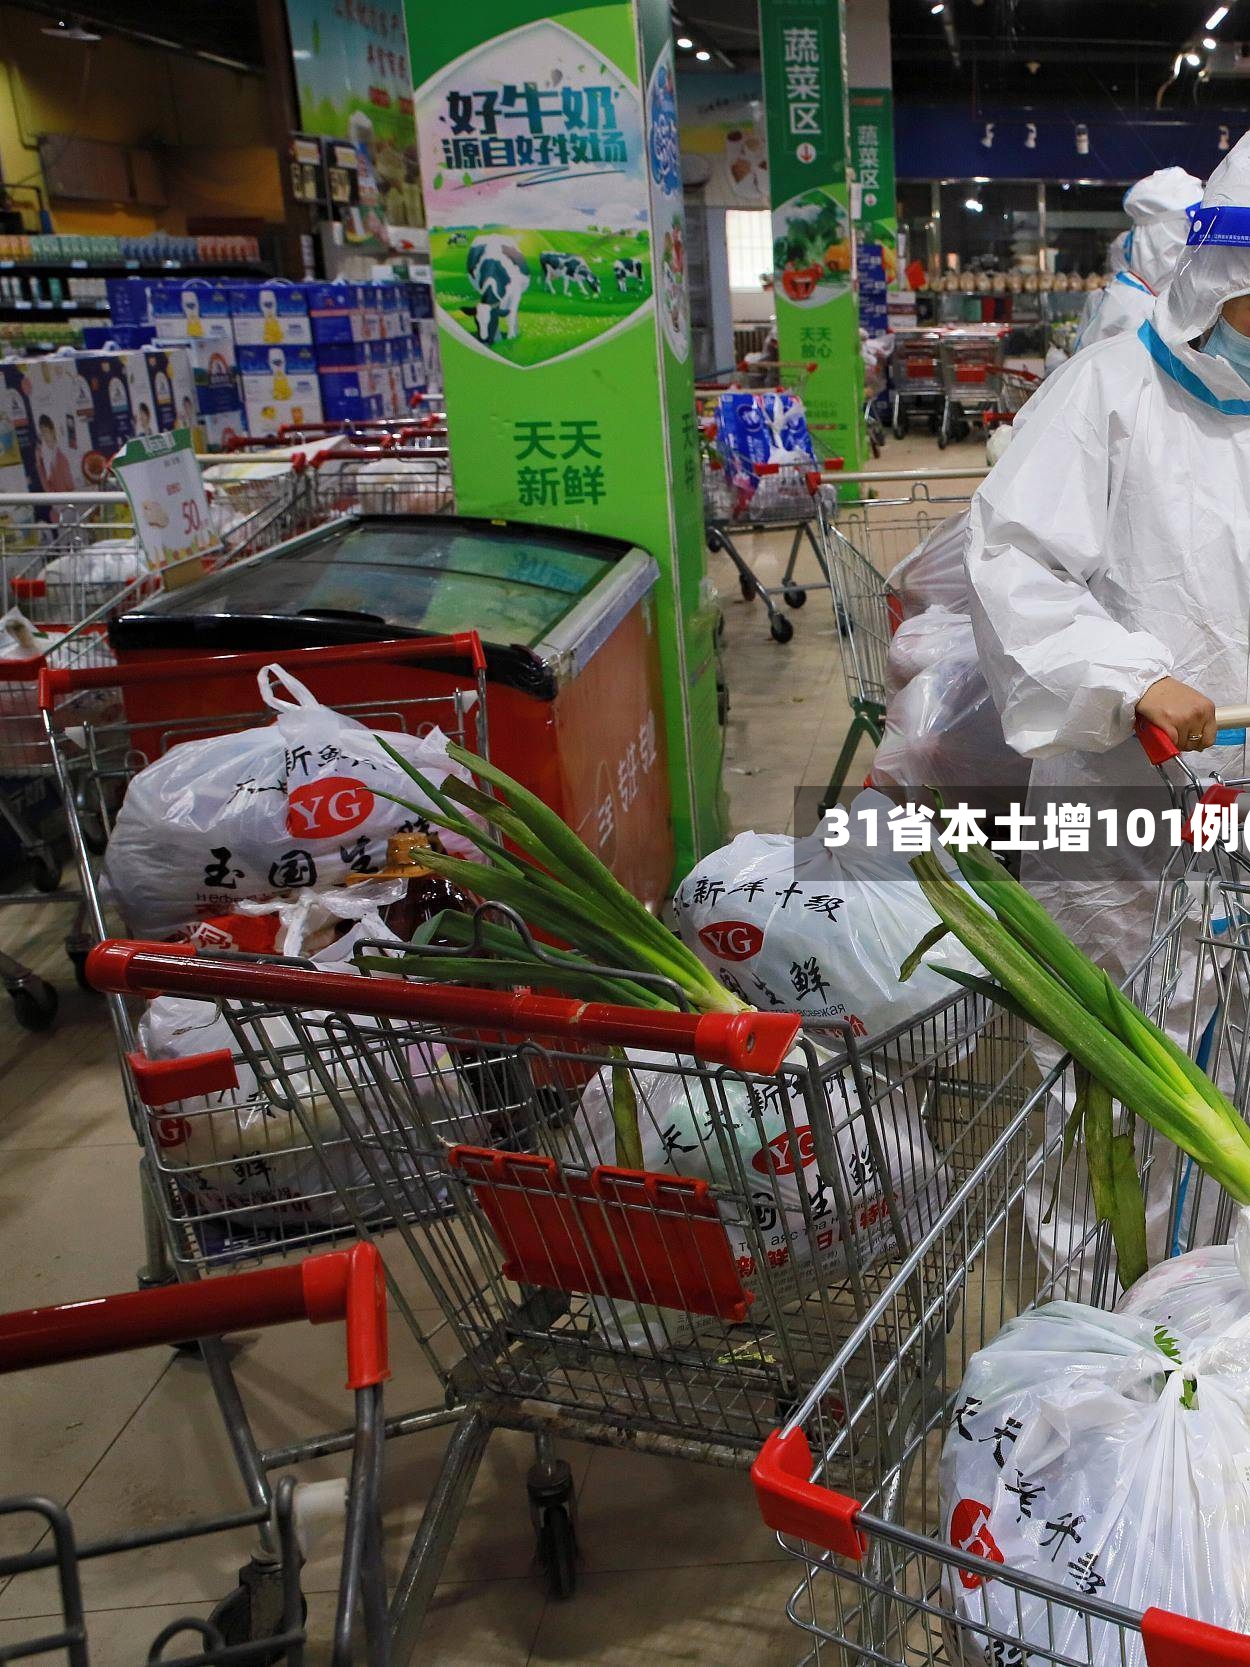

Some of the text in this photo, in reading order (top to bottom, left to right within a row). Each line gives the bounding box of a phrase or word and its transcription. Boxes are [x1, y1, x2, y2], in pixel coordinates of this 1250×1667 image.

[783, 27, 821, 134] 蔬菜区
[444, 82, 618, 136] 好牛奶
[441, 132, 628, 170] 源自好牧场
[857, 124, 880, 189] 蔬菜区
[513, 420, 603, 460] 天天
[517, 465, 606, 506] 新鲜
[290, 787, 362, 832] YG
[702, 927, 753, 955] YG
